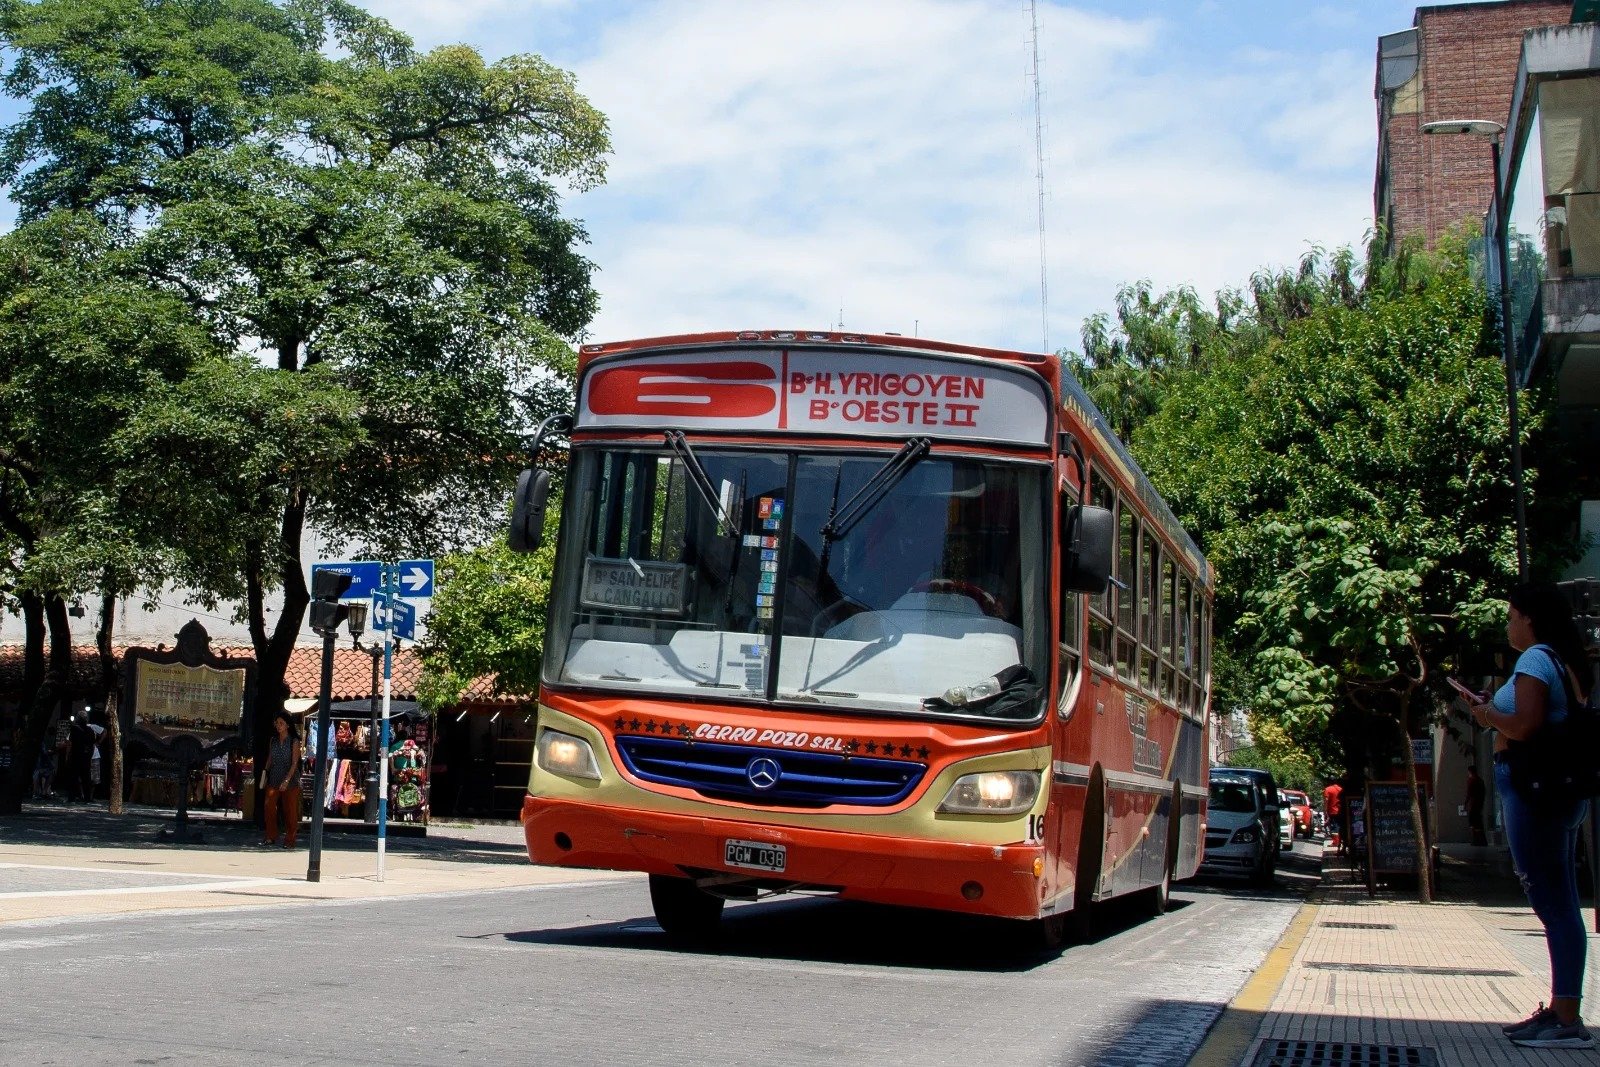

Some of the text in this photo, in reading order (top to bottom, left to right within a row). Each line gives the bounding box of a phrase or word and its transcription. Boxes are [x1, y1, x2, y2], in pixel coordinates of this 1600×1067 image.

[588, 362, 776, 418] 6
[838, 372, 985, 400] YRIGOYEN
[842, 399, 939, 425] OESTE
[942, 403, 980, 427] II
[609, 570, 635, 586] SAN
[695, 722, 758, 743] CERRO
[757, 728, 809, 748] POZO
[727, 845, 784, 867] PGW 038
